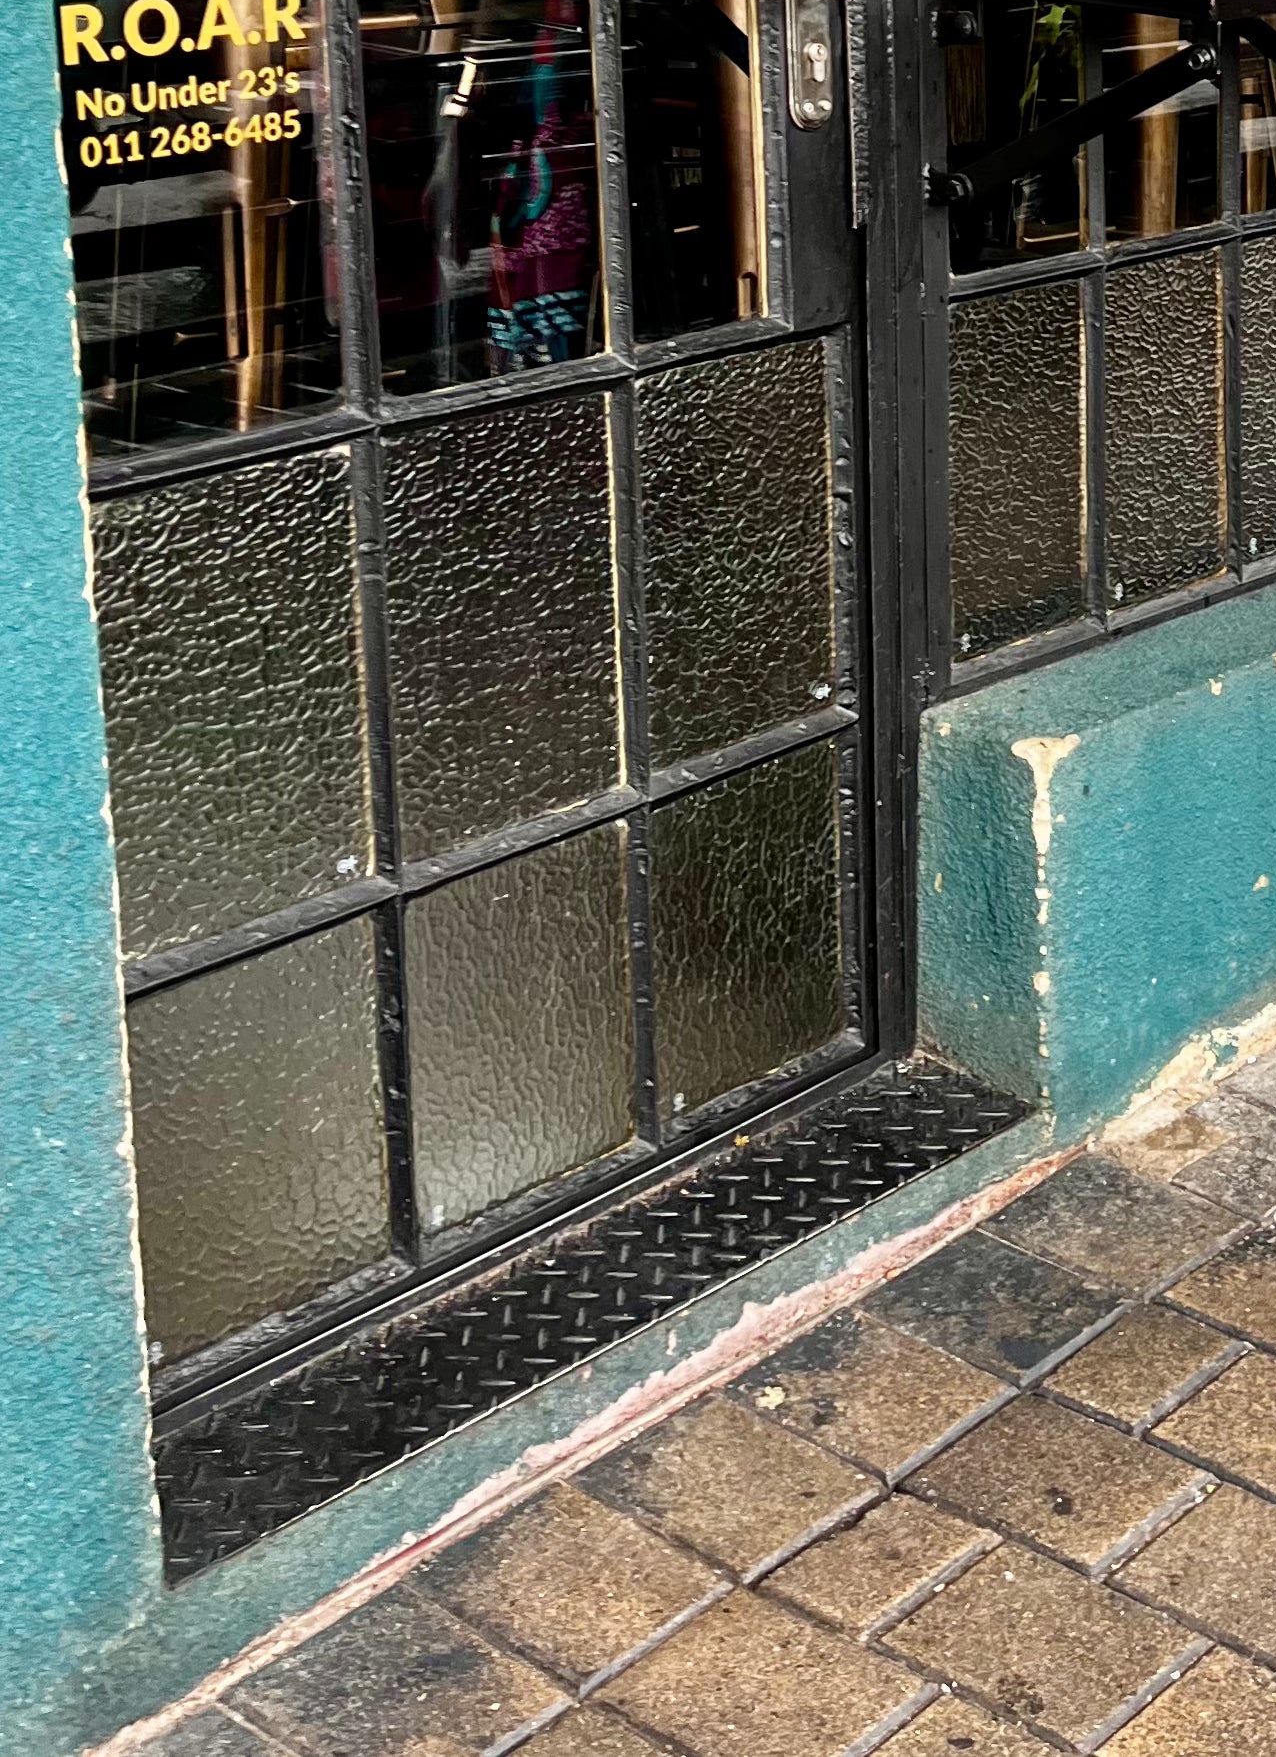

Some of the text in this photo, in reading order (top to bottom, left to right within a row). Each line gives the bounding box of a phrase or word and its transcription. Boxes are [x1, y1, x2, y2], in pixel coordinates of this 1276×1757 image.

[75, 65, 301, 121] No Under 23's
[79, 108, 302, 168] 011 268-6485
